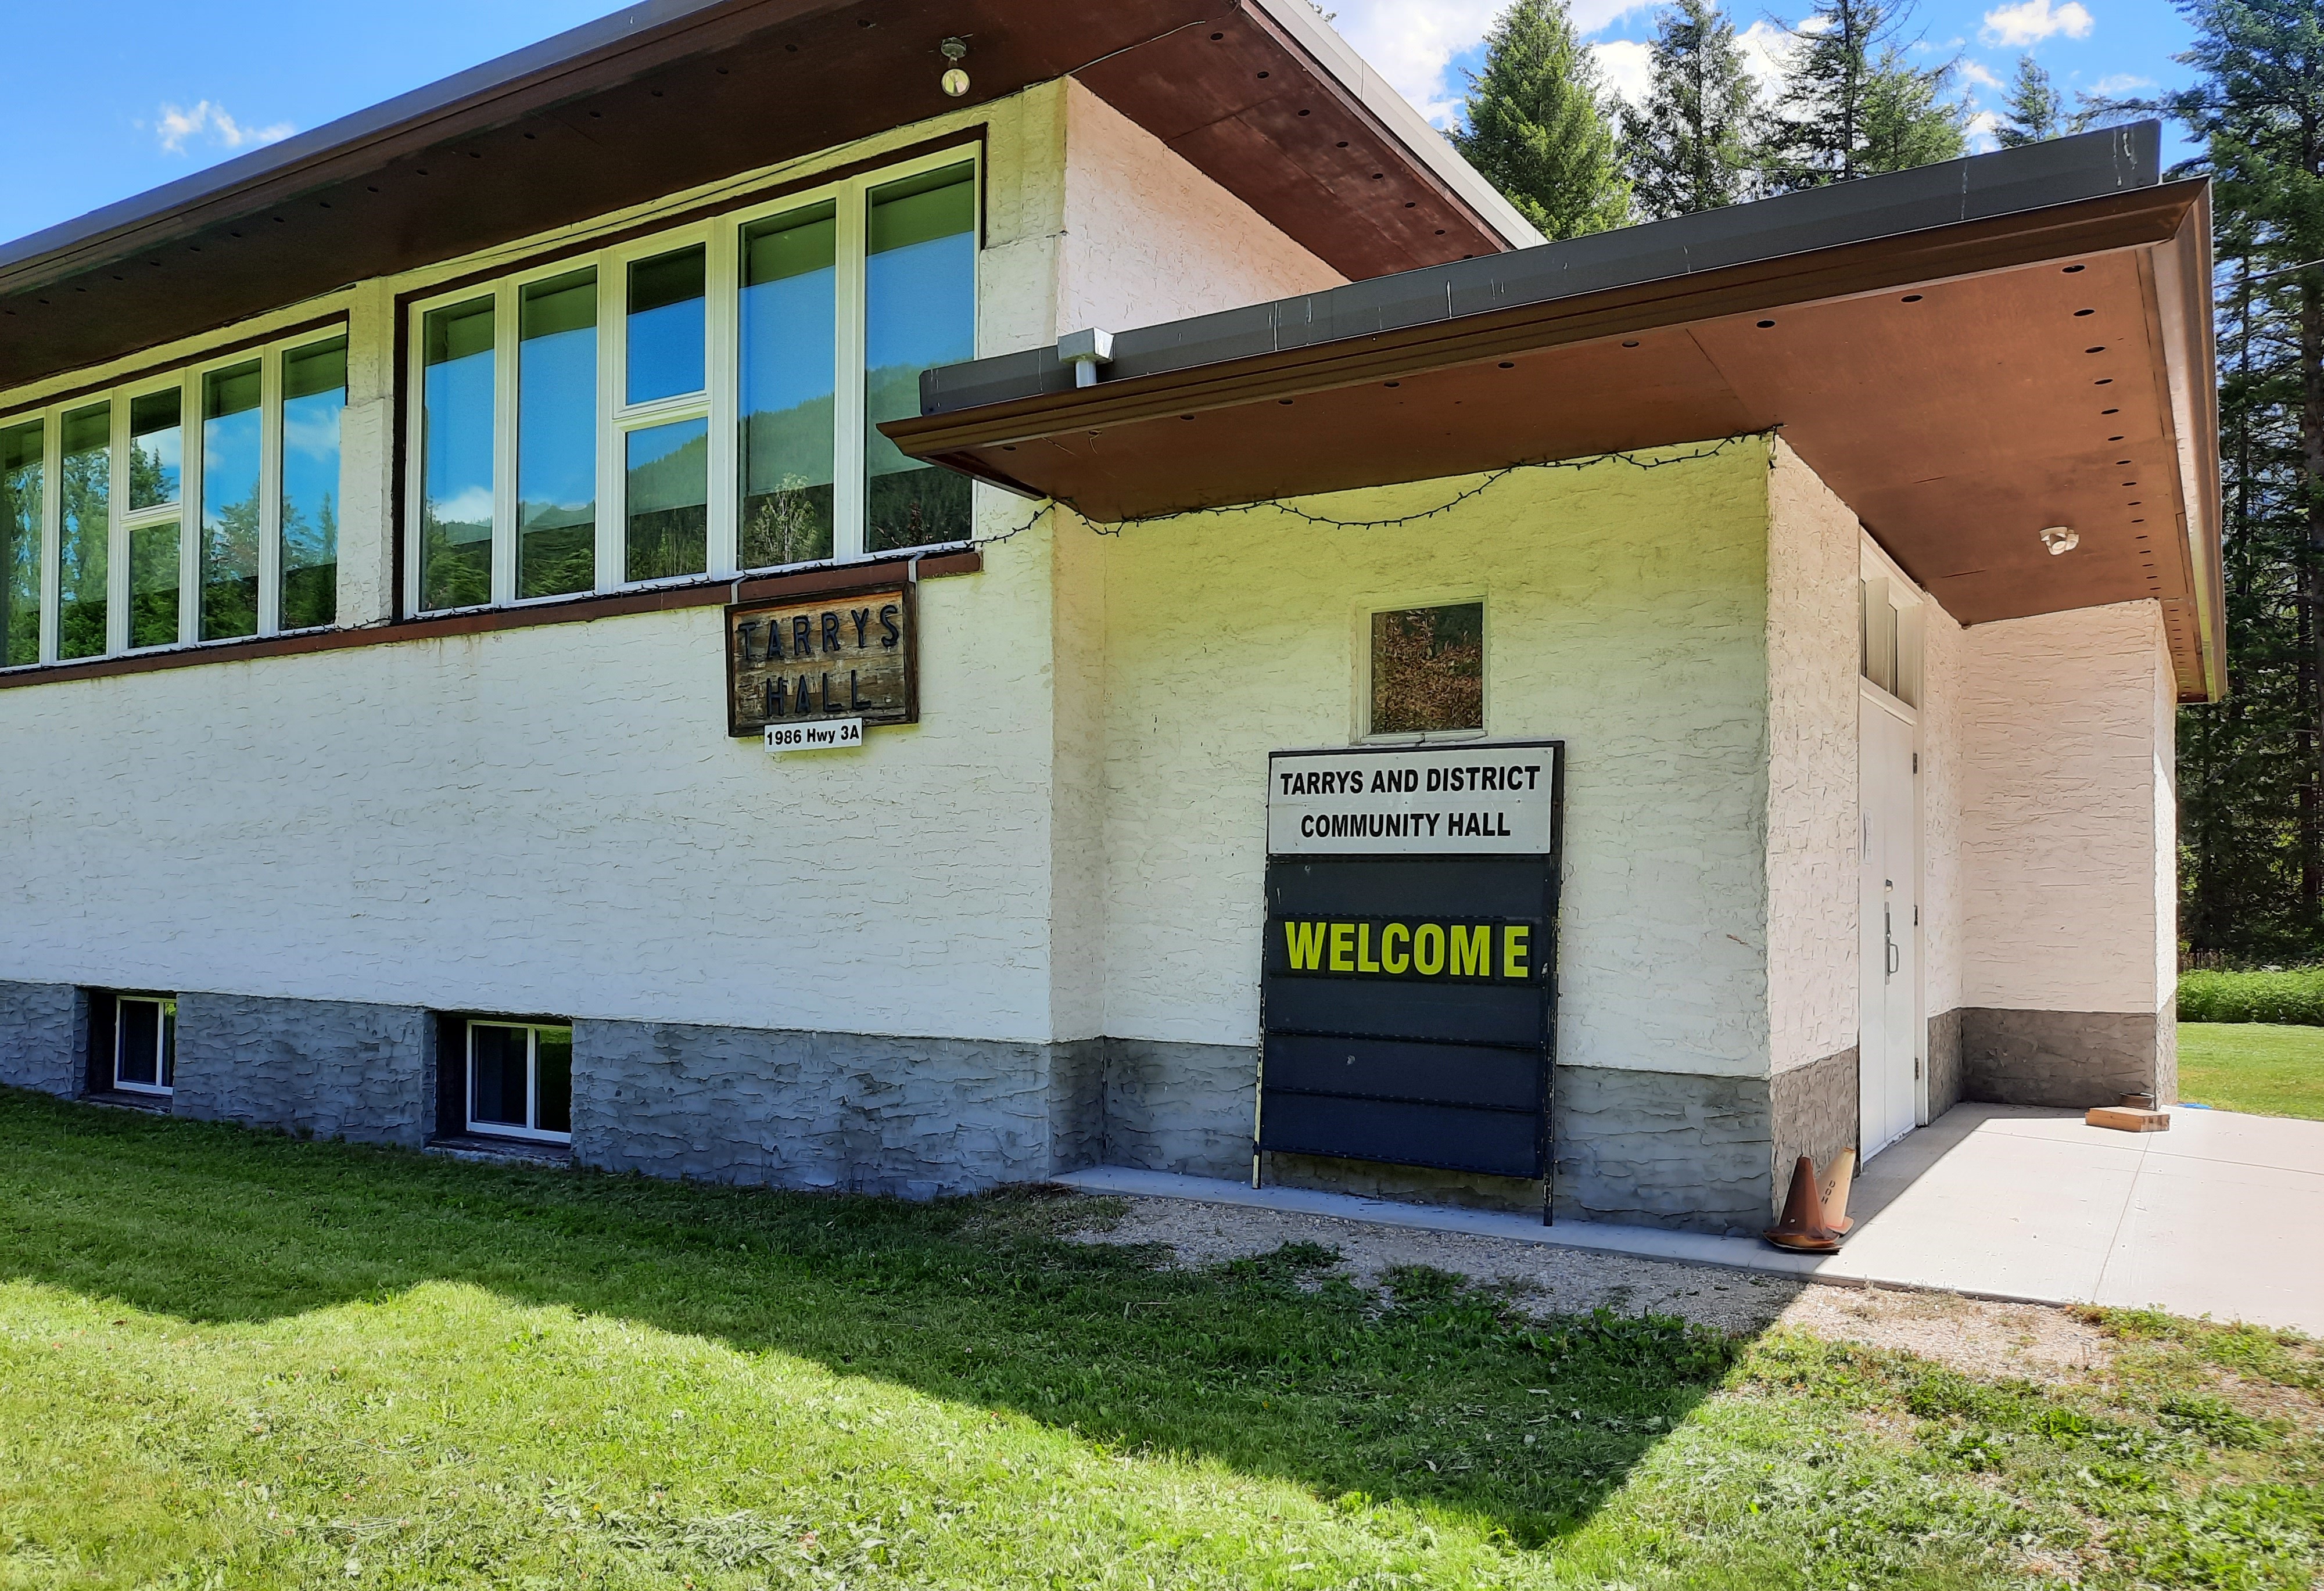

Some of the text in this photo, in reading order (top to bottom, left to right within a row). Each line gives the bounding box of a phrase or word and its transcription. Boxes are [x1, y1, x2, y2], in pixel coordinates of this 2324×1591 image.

[738, 605, 899, 660] TARRYS
[766, 670, 871, 716] HALL
[767, 725, 859, 745] 1986 Hwy 3A
[1280, 766, 1540, 795] TARRYS AND DISTRICT
[1301, 812, 1511, 838] COMMUNITY HALL
[1285, 921, 1529, 978] WELCOME
